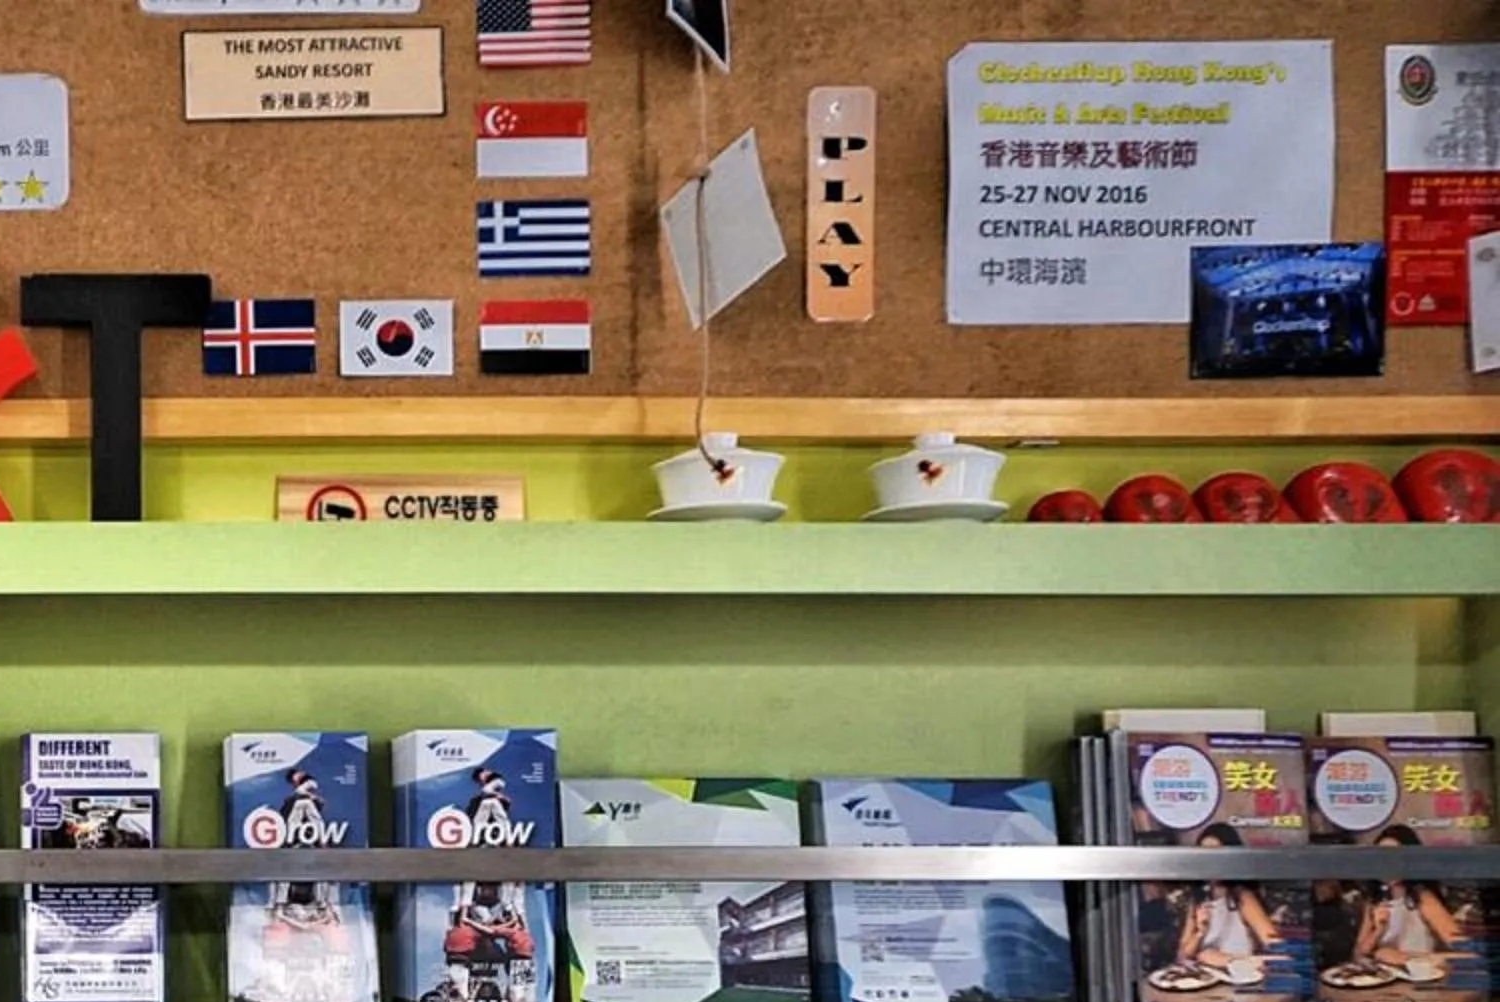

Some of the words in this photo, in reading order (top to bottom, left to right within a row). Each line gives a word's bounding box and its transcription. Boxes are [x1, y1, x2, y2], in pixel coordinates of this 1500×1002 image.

[224, 39, 253, 53] THE
[258, 38, 303, 53] MOST
[308, 36, 403, 51] ATTRACTIVE
[255, 65, 307, 79] SANDY
[312, 63, 373, 78] RESORT
[16, 139, 50, 157] 公里
[980, 140, 1198, 169] 香港音樂及藝術節
[980, 186, 1038, 204] 25-27
[1044, 186, 1092, 204] NOV
[1097, 186, 1148, 204] 2016
[979, 220, 1072, 239] CENTRAL
[1078, 219, 1255, 238] HARBOURFRONT
[980, 258, 1087, 286] 中環海濱
[38, 740, 111, 756] DIFFERENT
